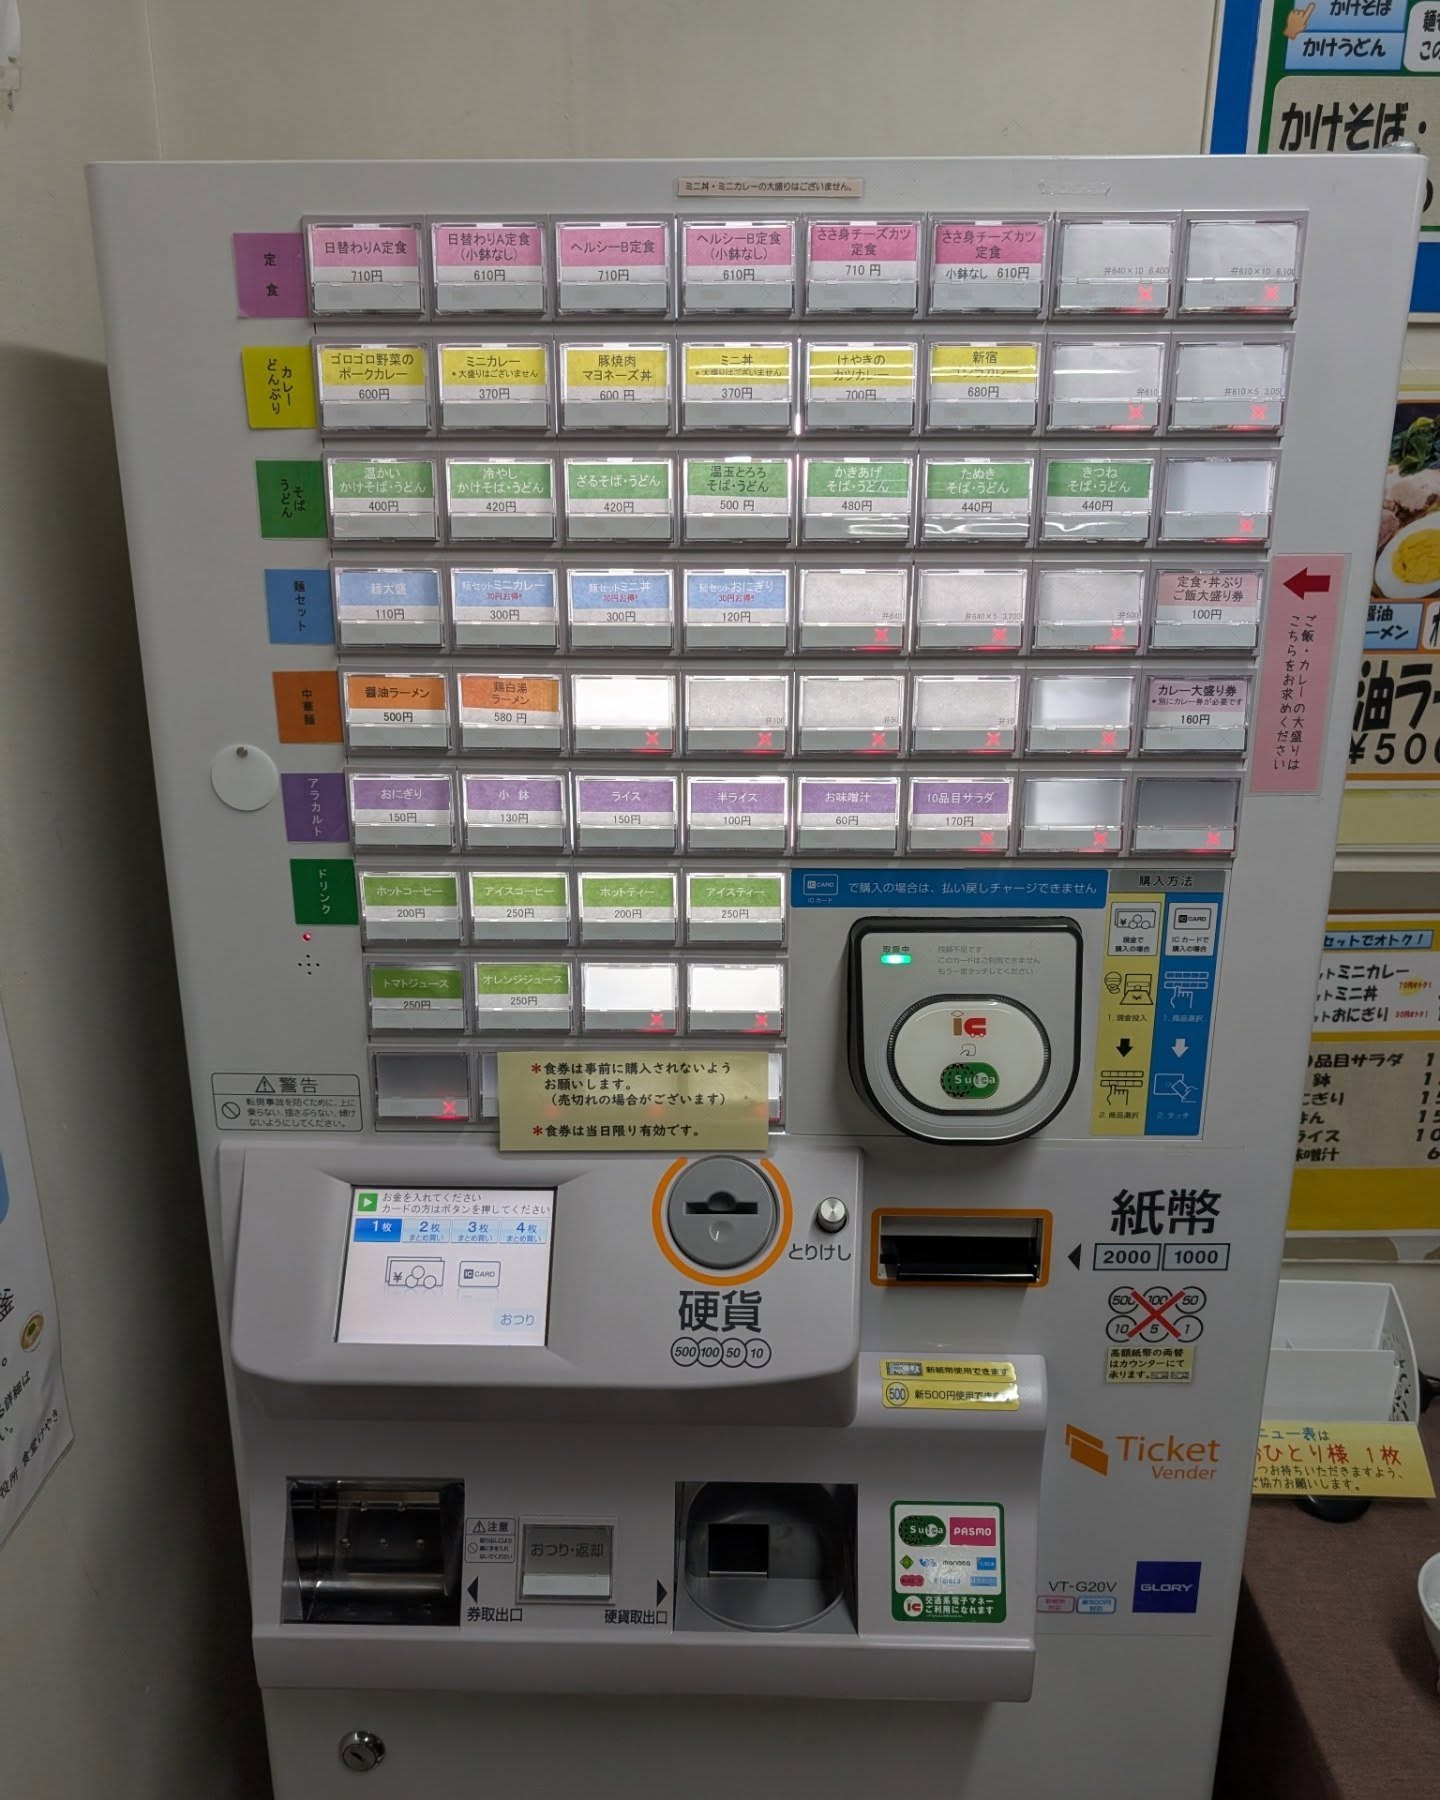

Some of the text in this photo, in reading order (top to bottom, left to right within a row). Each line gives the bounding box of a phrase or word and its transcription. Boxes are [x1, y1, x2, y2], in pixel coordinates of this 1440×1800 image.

[1302, 38, 1386, 58] かけうどん
[448, 232, 531, 247] 日替わりA定食
[696, 231, 782, 246] ヘルシーB定食
[817, 227, 911, 241] ささ身チーズカツ
[942, 230, 1036, 244] ささ身チーズカツ
[324, 241, 408, 256] 日替わりA定食
[570, 239, 656, 254] ヘルシーB定食
[850, 243, 877, 256] 定食
[975, 246, 1002, 259] 定食
[351, 269, 383, 282] 710円
[473, 269, 506, 282] 610円
[597, 269, 630, 282] 710円
[722, 268, 755, 281] 610円
[330, 353, 414, 366] ゴロゴロ野菜の
[466, 355, 521, 367] ミニカレー
[597, 354, 636, 368] 豚焼肉
[720, 354, 754, 365] ミニ丼
[837, 354, 886, 366] けやきの
[972, 351, 999, 364] 新宿
[339, 367, 408, 381] ポークカレー
[582, 369, 652, 382] マヨネーズ丼
[266, 358, 282, 415] どんぶり
[281, 366, 294, 407] カレー
[721, 387, 753, 399] 370円
[967, 386, 1000, 398] 680円
[358, 387, 390, 400] 600円
[478, 387, 510, 400] 370円
[845, 389, 877, 400] 700円
[364, 467, 400, 479] 温かい
[482, 467, 519, 480] 冷やし
[710, 465, 767, 479] 温玉とろろ
[834, 466, 883, 479] かきあげ
[961, 468, 996, 480] たぬき
[1082, 466, 1118, 479] きつね
[339, 480, 427, 494] かけそば・うどん
[576, 474, 661, 487] ざるそば・うどん
[706, 479, 769, 493] そば・うどん
[826, 480, 890, 493] そば・うどん
[1067, 480, 1131, 493] そば・うどん
[457, 481, 544, 494] かけそば・うどん
[946, 481, 1009, 495] そば・うどん
[279, 478, 293, 519] うどん
[293, 486, 306, 513] そば
[368, 500, 399, 512] 400円
[485, 500, 517, 512] 420円
[603, 502, 634, 513] 420円
[841, 500, 873, 512] 480円
[961, 502, 993, 513] 440円
[1082, 500, 1113, 512] 440円
[1177, 576, 1243, 589] 定食・丼ぶり
[1173, 588, 1244, 602] ご飯大盛り券
[375, 608, 405, 620] 110円
[489, 608, 520, 621] 300円
[606, 611, 636, 622] 300円
[721, 611, 751, 623] 120円
[1191, 608, 1223, 620] 100円
[364, 686, 431, 699] 醤油ラーメン
[1157, 685, 1237, 697] カレー大盛り券
[1274, 614, 1300, 770] こちらをお求めください
[1287, 614, 1318, 771] ご飯・カレーの大盛りは
[490, 694, 530, 705] ラーメン
[383, 711, 413, 723] 500円
[1180, 714, 1210, 725] 160円
[380, 788, 423, 800] おにぎり
[611, 791, 642, 802] ライス
[716, 791, 759, 803] 半ライス
[824, 791, 871, 804] お味噌汁
[926, 791, 995, 804] 10品目サラダ
[307, 777, 323, 837] アラカルト
[388, 811, 418, 823] 150円
[500, 813, 530, 824] 130円
[612, 814, 641, 825] 150円
[723, 815, 751, 826] 100円
[835, 815, 859, 826] 60円
[945, 816, 974, 827] 170円
[1138, 875, 1193, 887] 購入方法
[318, 868, 332, 915] ドリンク
[376, 885, 444, 897] ホットコーヒー
[483, 886, 555, 897] アイスコーヒー
[600, 886, 655, 898] ホットティー
[706, 887, 765, 898] アイスティー
[847, 881, 1098, 895] で購入の場合は、払い戻しチャージできません
[397, 908, 426, 919] 200円
[506, 907, 535, 919] 250円
[614, 909, 642, 920] 200円
[721, 909, 749, 920] 250円
[383, 978, 449, 990] トマトジュース
[482, 975, 564, 985] オレンジジュース
[279, 1076, 318, 1094] 警告
[544, 1078, 632, 1091] お願いします。
[383, 1192, 482, 1203] お金を入れてください
[382, 1204, 550, 1215] カードの方はボタンを押してください
[1110, 1188, 1222, 1236] 紙幣
[372, 1220, 537, 1234] 1枚 2枚 3枚 4枚
[409, 1234, 542, 1243] まとめ買い まとめ買い まとめ買い
[788, 1243, 852, 1261] とりけし
[1102, 1250, 1219, 1264] 2000 1000
[1181, 1295, 1198, 1306] 50
[678, 1289, 763, 1333] 硬貨
[500, 1313, 535, 1326] おつり
[1114, 1324, 1159, 1334] 10 5
[675, 1346, 764, 1359] 500 100 50 10
[1109, 1359, 1185, 1368] はカウンターにて
[888, 1389, 907, 1401] 500
[1116, 1435, 1221, 1463] Ticket
[1366, 1444, 1401, 1465] 1枚
[1151, 1465, 1217, 1480] Vender
[487, 1521, 509, 1533] 注意
[953, 1527, 992, 1536] PASMO
[530, 1542, 604, 1558] おつり・返却
[1048, 1581, 1118, 1593] VT-G20V
[1140, 1583, 1193, 1592] GLORY
[467, 1607, 668, 1625] 券取出口 硬貨取出口
[925, 1605, 994, 1615] ご利用になれます
